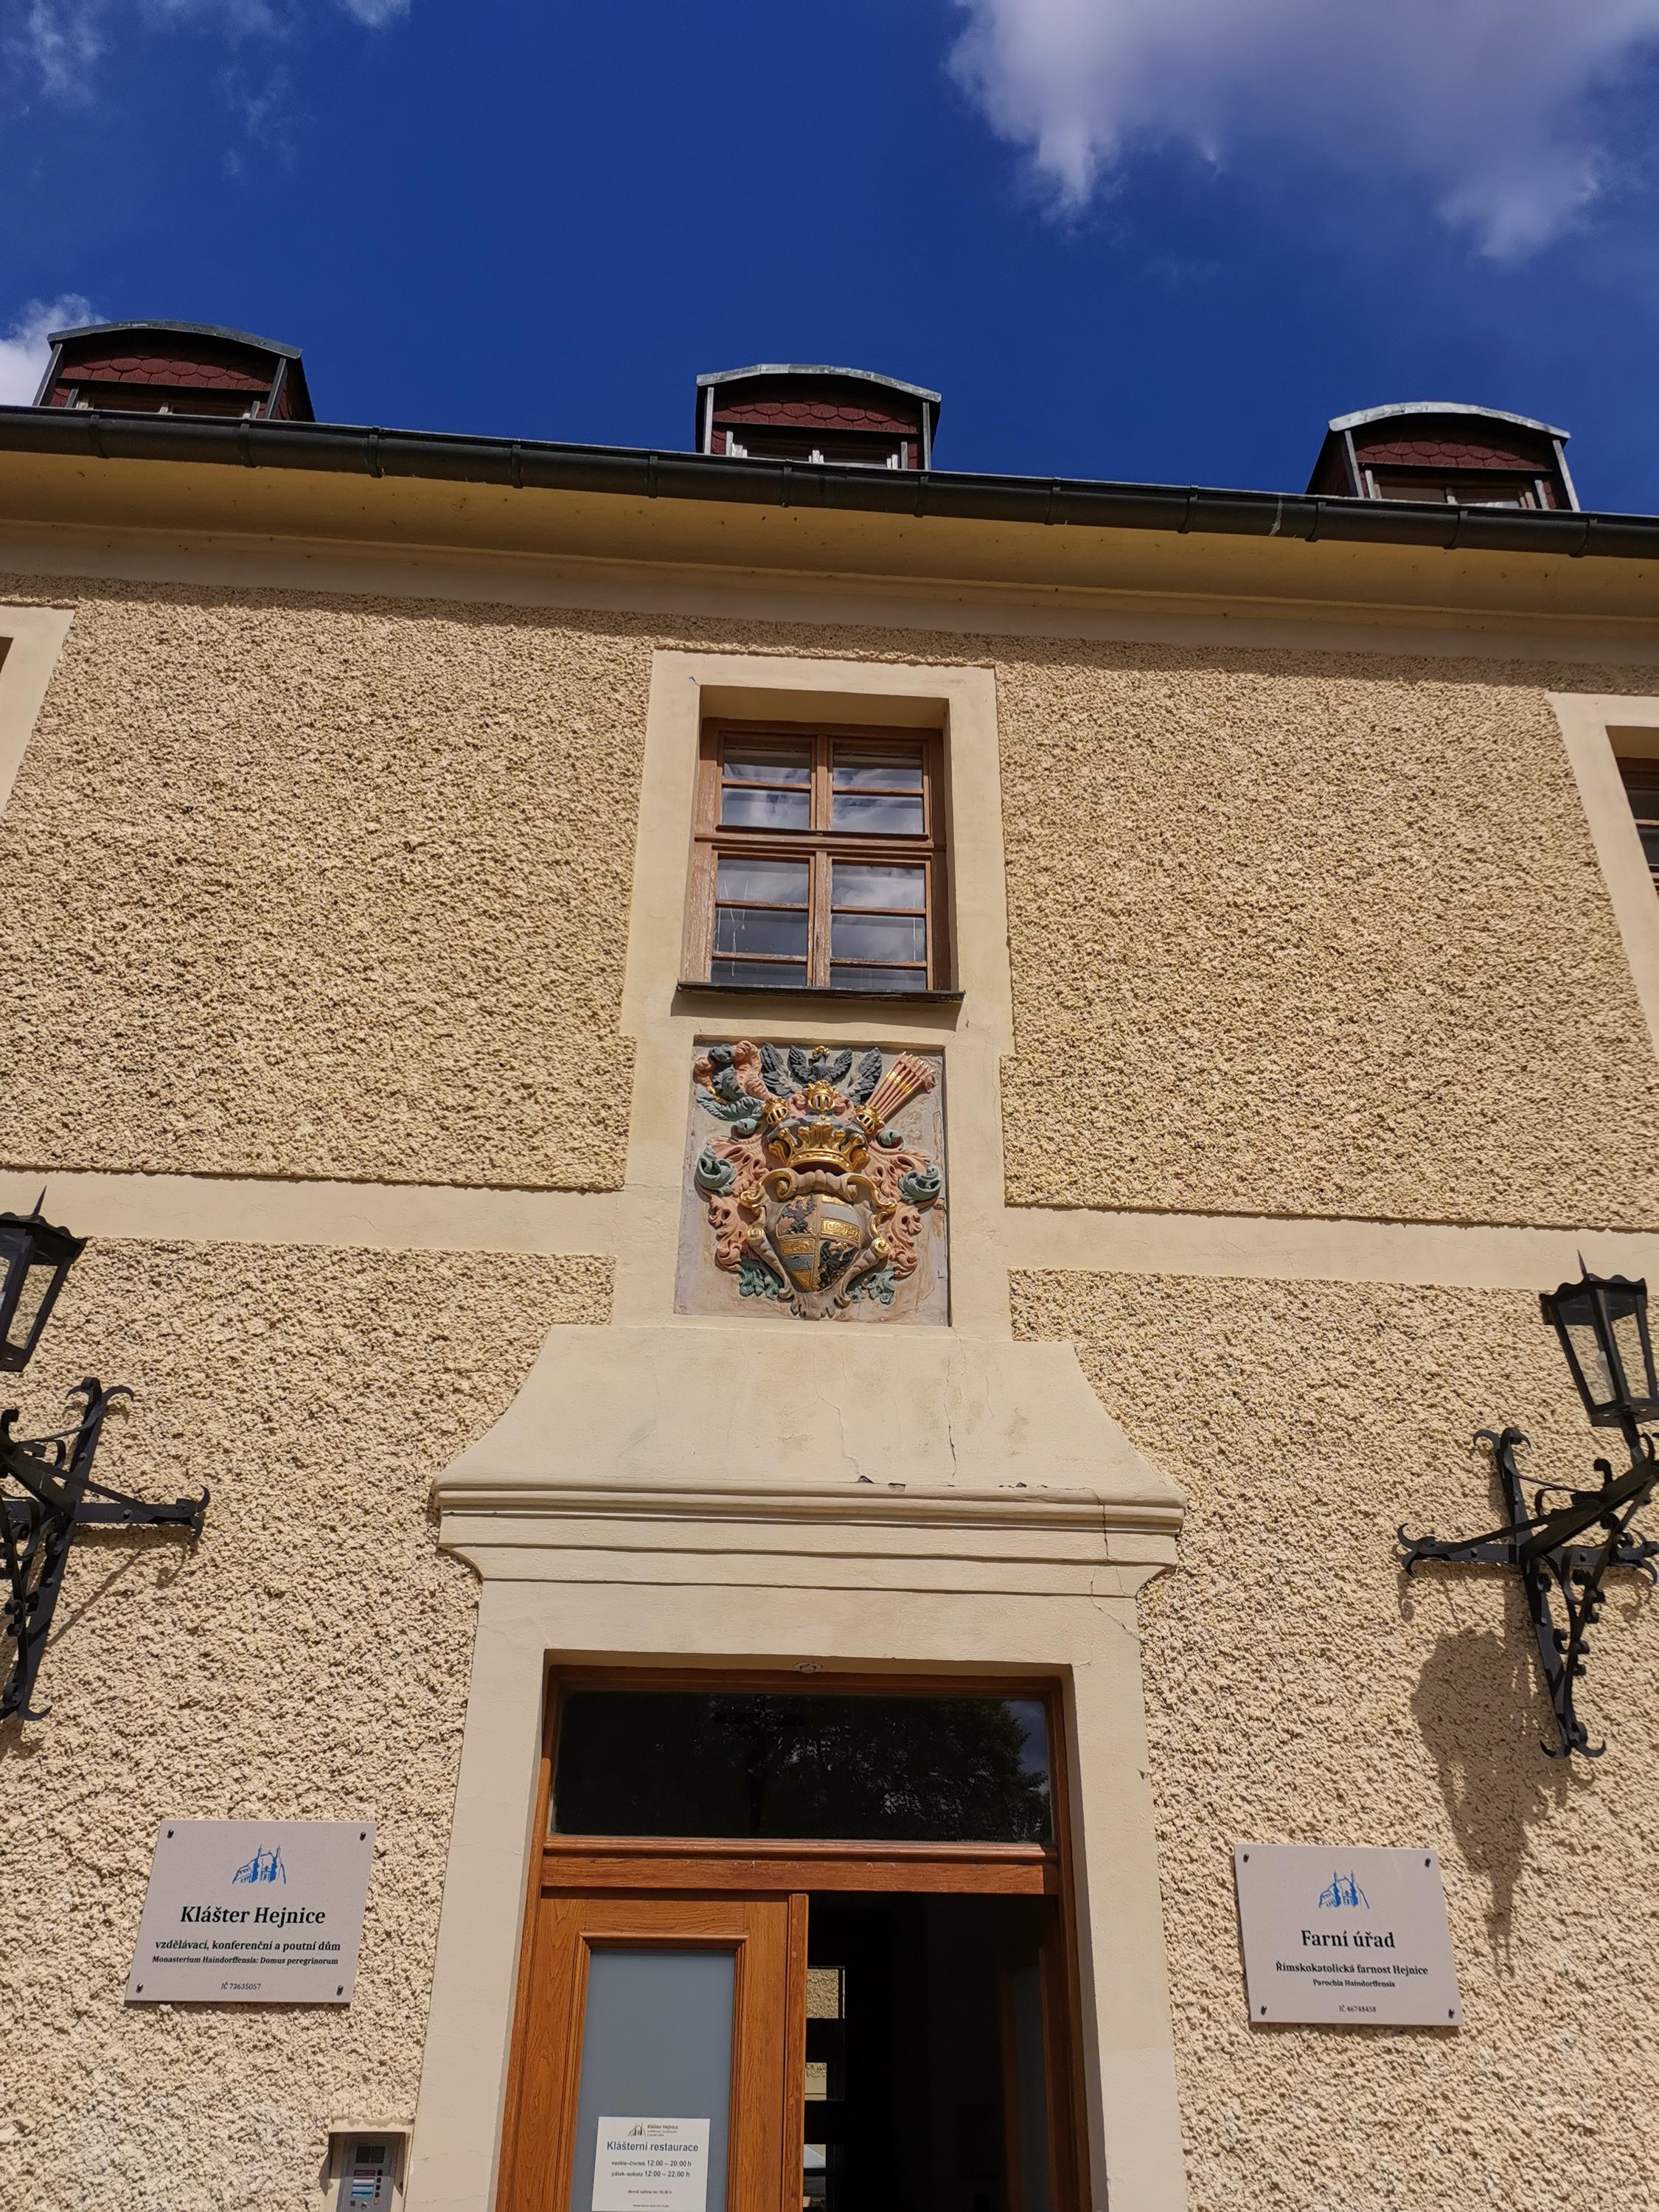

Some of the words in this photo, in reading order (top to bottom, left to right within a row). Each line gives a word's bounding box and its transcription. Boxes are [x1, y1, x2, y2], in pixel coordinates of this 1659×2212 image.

[180, 1906, 250, 1924] Klášter
[254, 1907, 325, 1927] Hejnice
[1301, 1930, 1348, 1947] Farní
[1354, 1931, 1395, 1948] úřad
[156, 1940, 209, 1950] vzdělávací,
[212, 1941, 272, 1950] konferenční
[282, 1941, 316, 1952] poutní
[319, 1941, 340, 1951] dům
[287, 1958, 338, 1966] peregrinorum
[1276, 1961, 1354, 1973] Římskokatolická
[1357, 1964, 1391, 1975] farnost
[1393, 1965, 1428, 1976] Hejnice
[221, 1981, 229, 1989] IČ
[607, 2141, 647, 2151] Klášterní
[650, 2143, 698, 2152] restaurace
